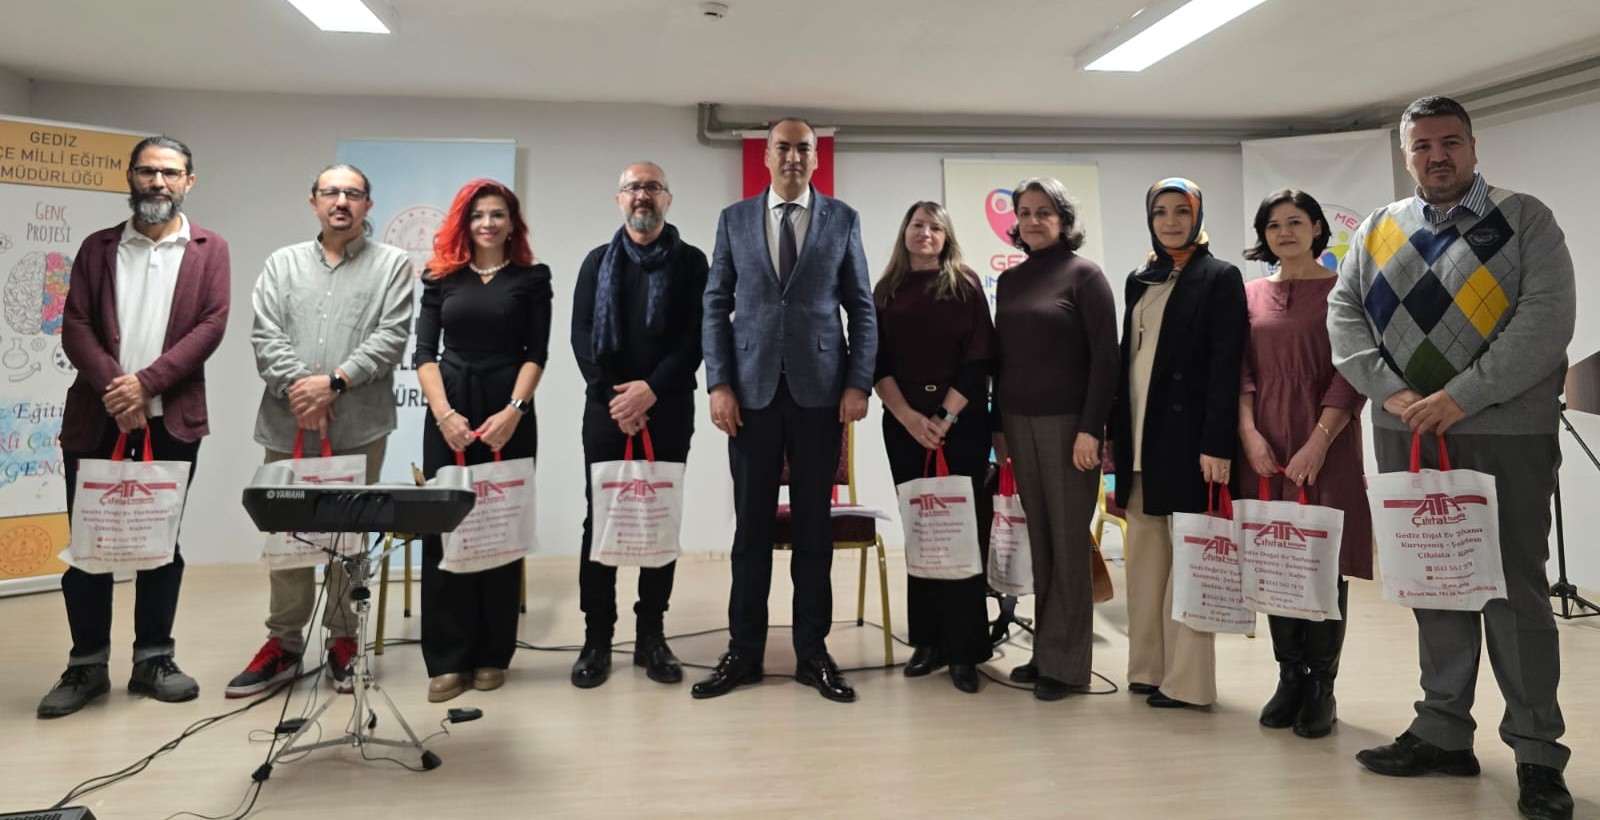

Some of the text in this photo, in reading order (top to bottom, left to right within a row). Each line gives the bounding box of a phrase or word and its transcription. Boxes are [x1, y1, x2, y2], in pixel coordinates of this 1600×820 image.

[30, 131, 77, 148] GEDİZ
[21, 147, 64, 164] MİLLİ
[70, 152, 122, 170] EĞİTİM
[1, 165, 104, 187] MÜDÜRLÜĞÜ
[35, 201, 68, 225] GENÇ
[27, 222, 72, 244] PROJESİ
[990, 254, 1028, 271] GE
[104, 480, 153, 498] ATA
[276, 490, 305, 500] YAMAHA
[1413, 493, 1462, 516] ATA
[1256, 521, 1305, 541] ATA
